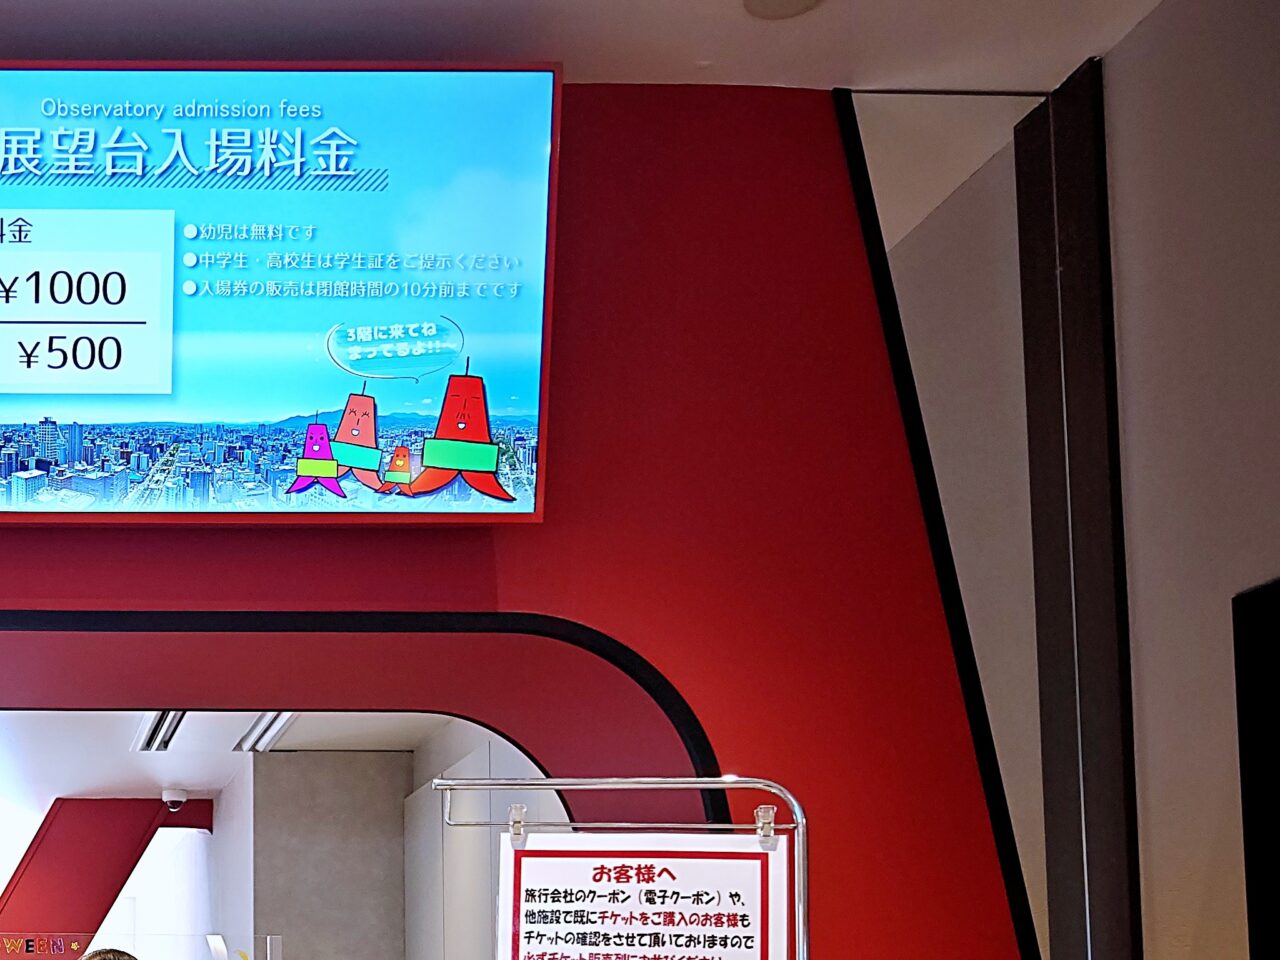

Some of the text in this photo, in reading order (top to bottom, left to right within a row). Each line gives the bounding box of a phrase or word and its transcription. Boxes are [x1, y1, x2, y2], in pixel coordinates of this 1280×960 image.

[40, 98, 322, 120] Observatory admission fees
[200, 223, 317, 241] 幼児は無料です
[18, 336, 123, 370] ¥500
[592, 864, 676, 883] お客様へ
[524, 910, 751, 928] 他施設で既にチケットをご購入のお客様も
[524, 931, 754, 949] チケットの確認をさせて頂いておりますので
